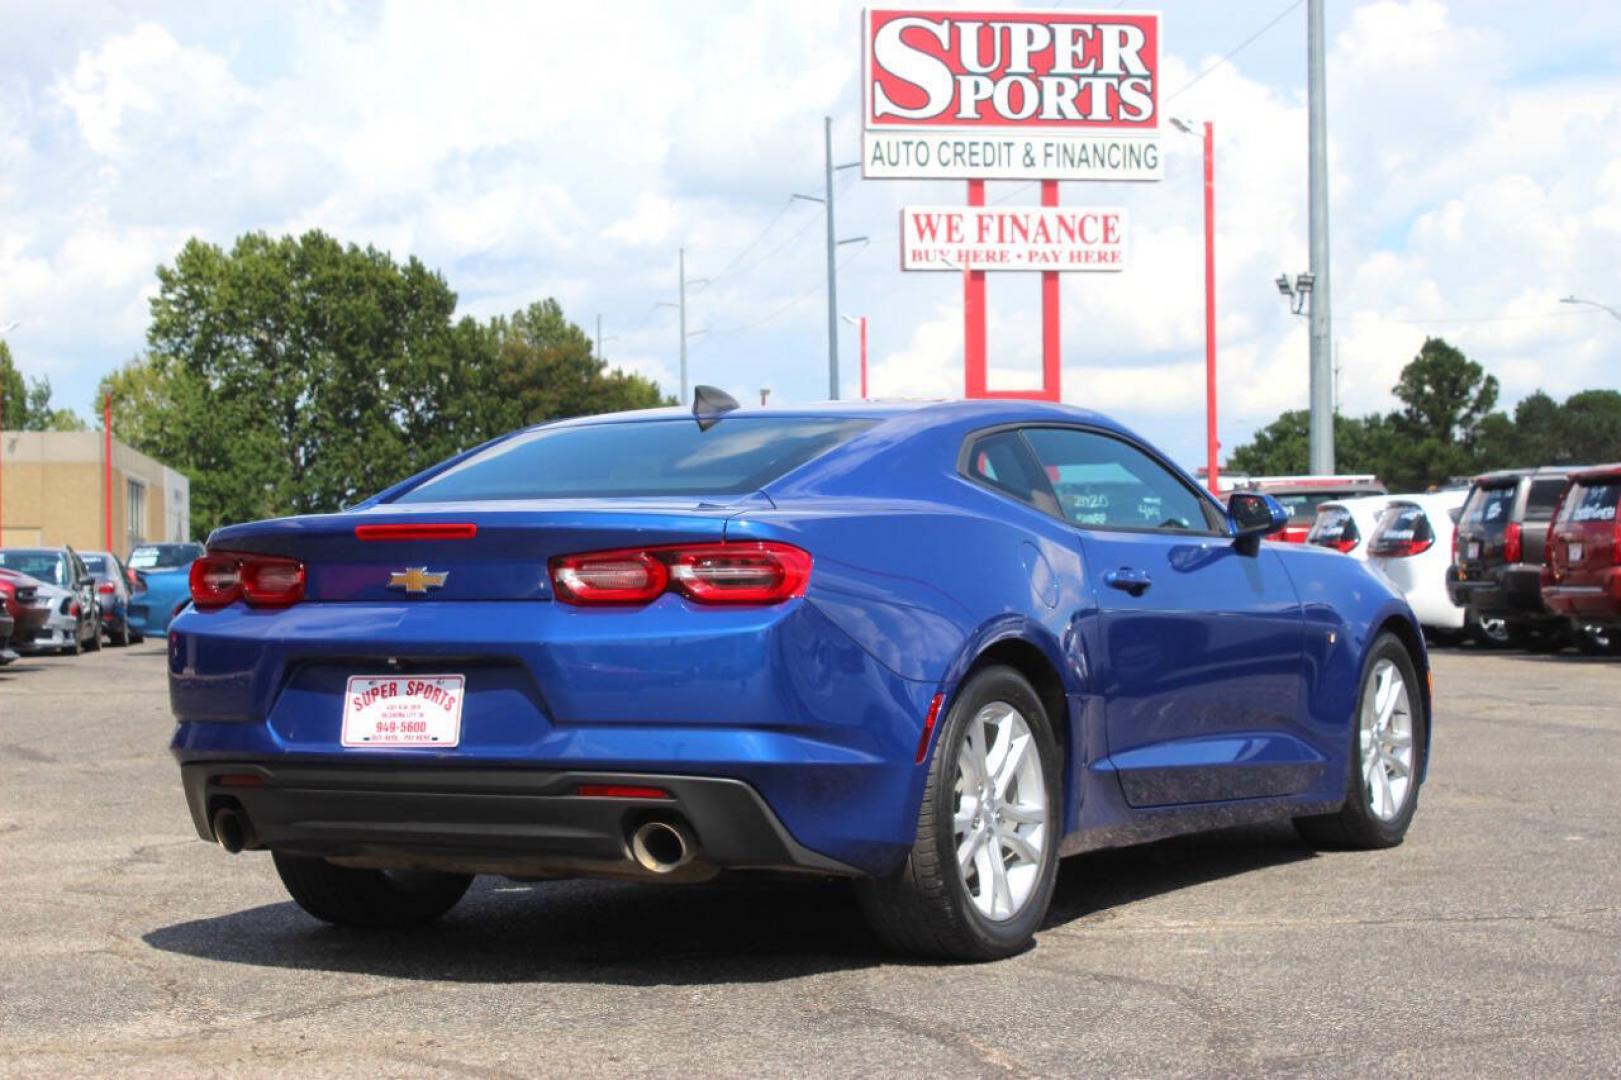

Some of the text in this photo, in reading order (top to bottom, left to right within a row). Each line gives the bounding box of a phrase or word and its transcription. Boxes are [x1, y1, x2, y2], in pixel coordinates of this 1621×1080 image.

[874, 17, 1151, 120] SUPER
[871, 141, 1158, 170] AUTO CREDIT & FINANCING
[912, 213, 1121, 244] WE FINANCE
[957, 249, 1010, 263] HERE
[1028, 250, 1061, 263] PAY
[1069, 250, 1122, 264] HERE
[353, 680, 456, 711] SUPER SPORTS
